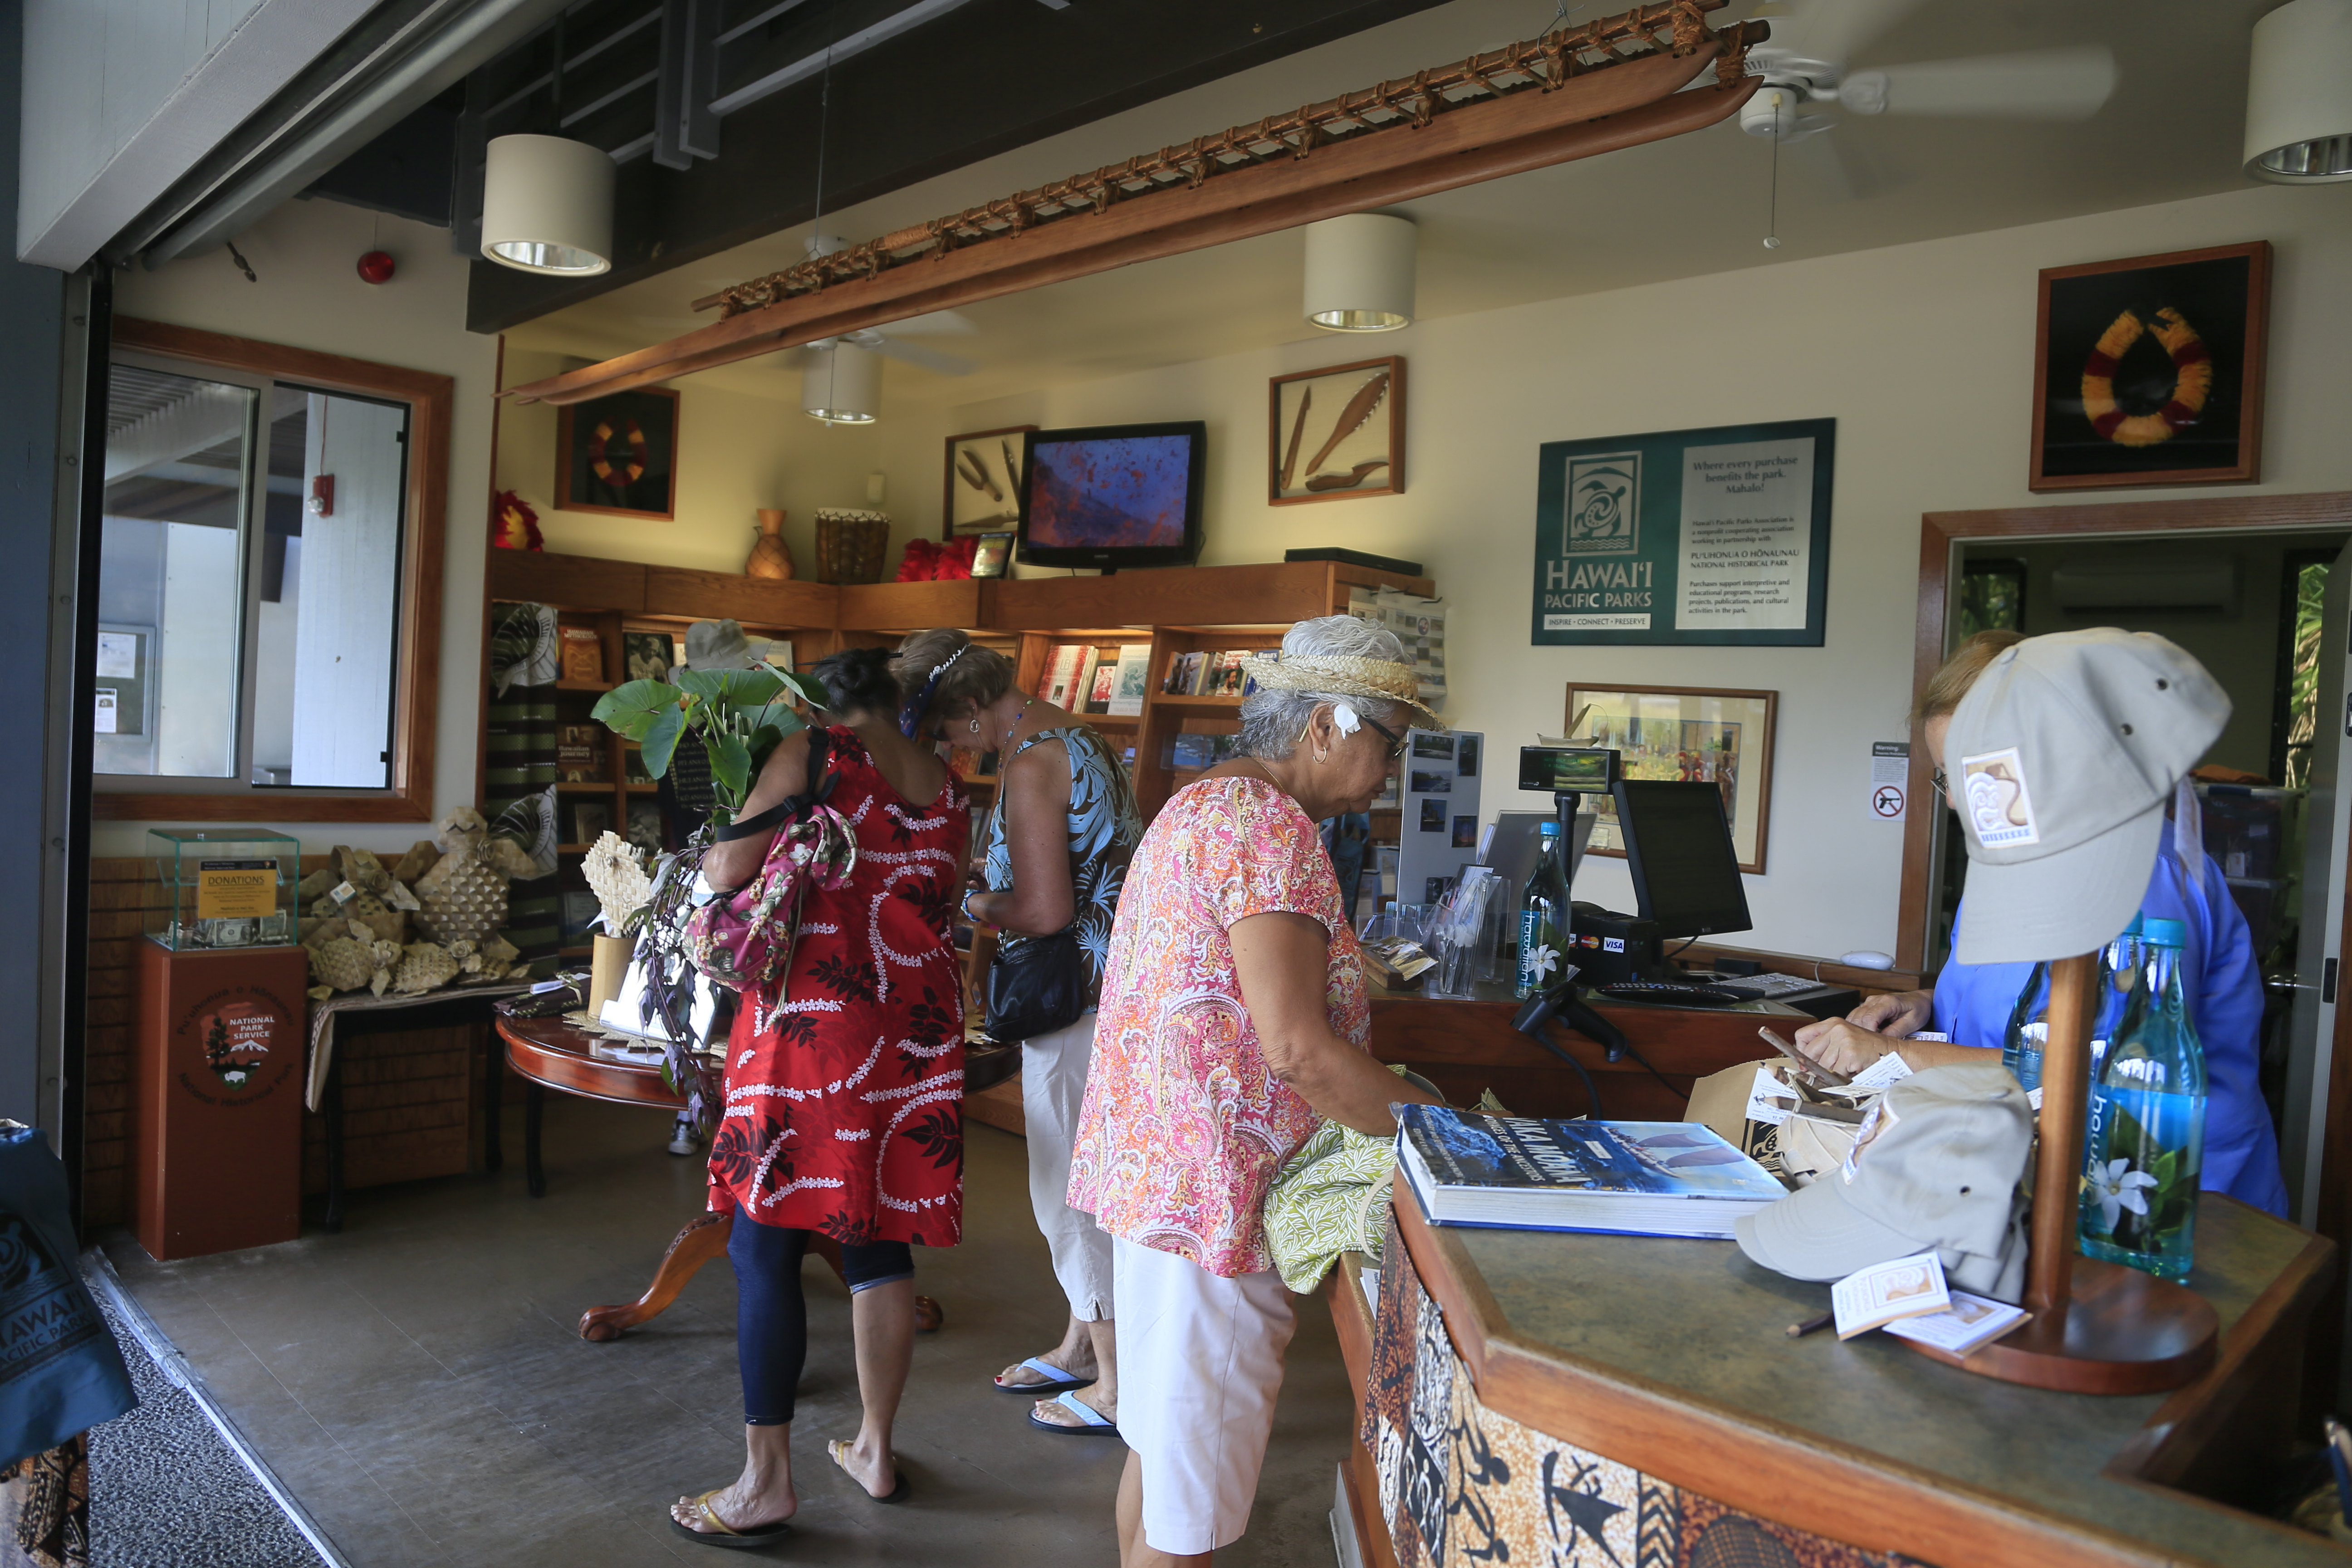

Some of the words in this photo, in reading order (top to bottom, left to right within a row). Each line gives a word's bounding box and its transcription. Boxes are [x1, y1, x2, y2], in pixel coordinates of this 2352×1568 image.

[1693, 461, 1724, 470] Where
[1726, 460, 1752, 469] every
[1755, 456, 1798, 470] purchase
[1705, 471, 1742, 482] benefits
[1744, 470, 1760, 480] the
[1762, 468, 1786, 481] park.
[1726, 482, 1764, 493] Mahalo!
[1697, 528, 1724, 536] nonprofit
[1725, 527, 1760, 535] cooperating
[1724, 535, 1757, 544] partnership
[1743, 579, 1777, 587] interpretive
[1545, 593, 1600, 608] PACIFIC
[1605, 592, 1652, 607] PARKS
[1715, 598, 1751, 606] publications,
[208, 876, 264, 885] DONATIONS
[1521, 915, 1535, 981] hawaiian
[1605, 940, 1623, 949] VISA
[230, 1016, 274, 1025] NATIONAL
[234, 1031, 270, 1039] SERVICE
[178, 1072, 217, 1104] National
[220, 1086, 275, 1107] Historical
[274, 1062, 295, 1086] Park
[1502, 1117, 1552, 1142] VAKA
[1498, 1136, 1513, 1145] OF
[1504, 1143, 1520, 1154] THE
[1512, 1152, 1545, 1182] ANCESTORS
[1524, 1144, 1592, 1183] MOANA
